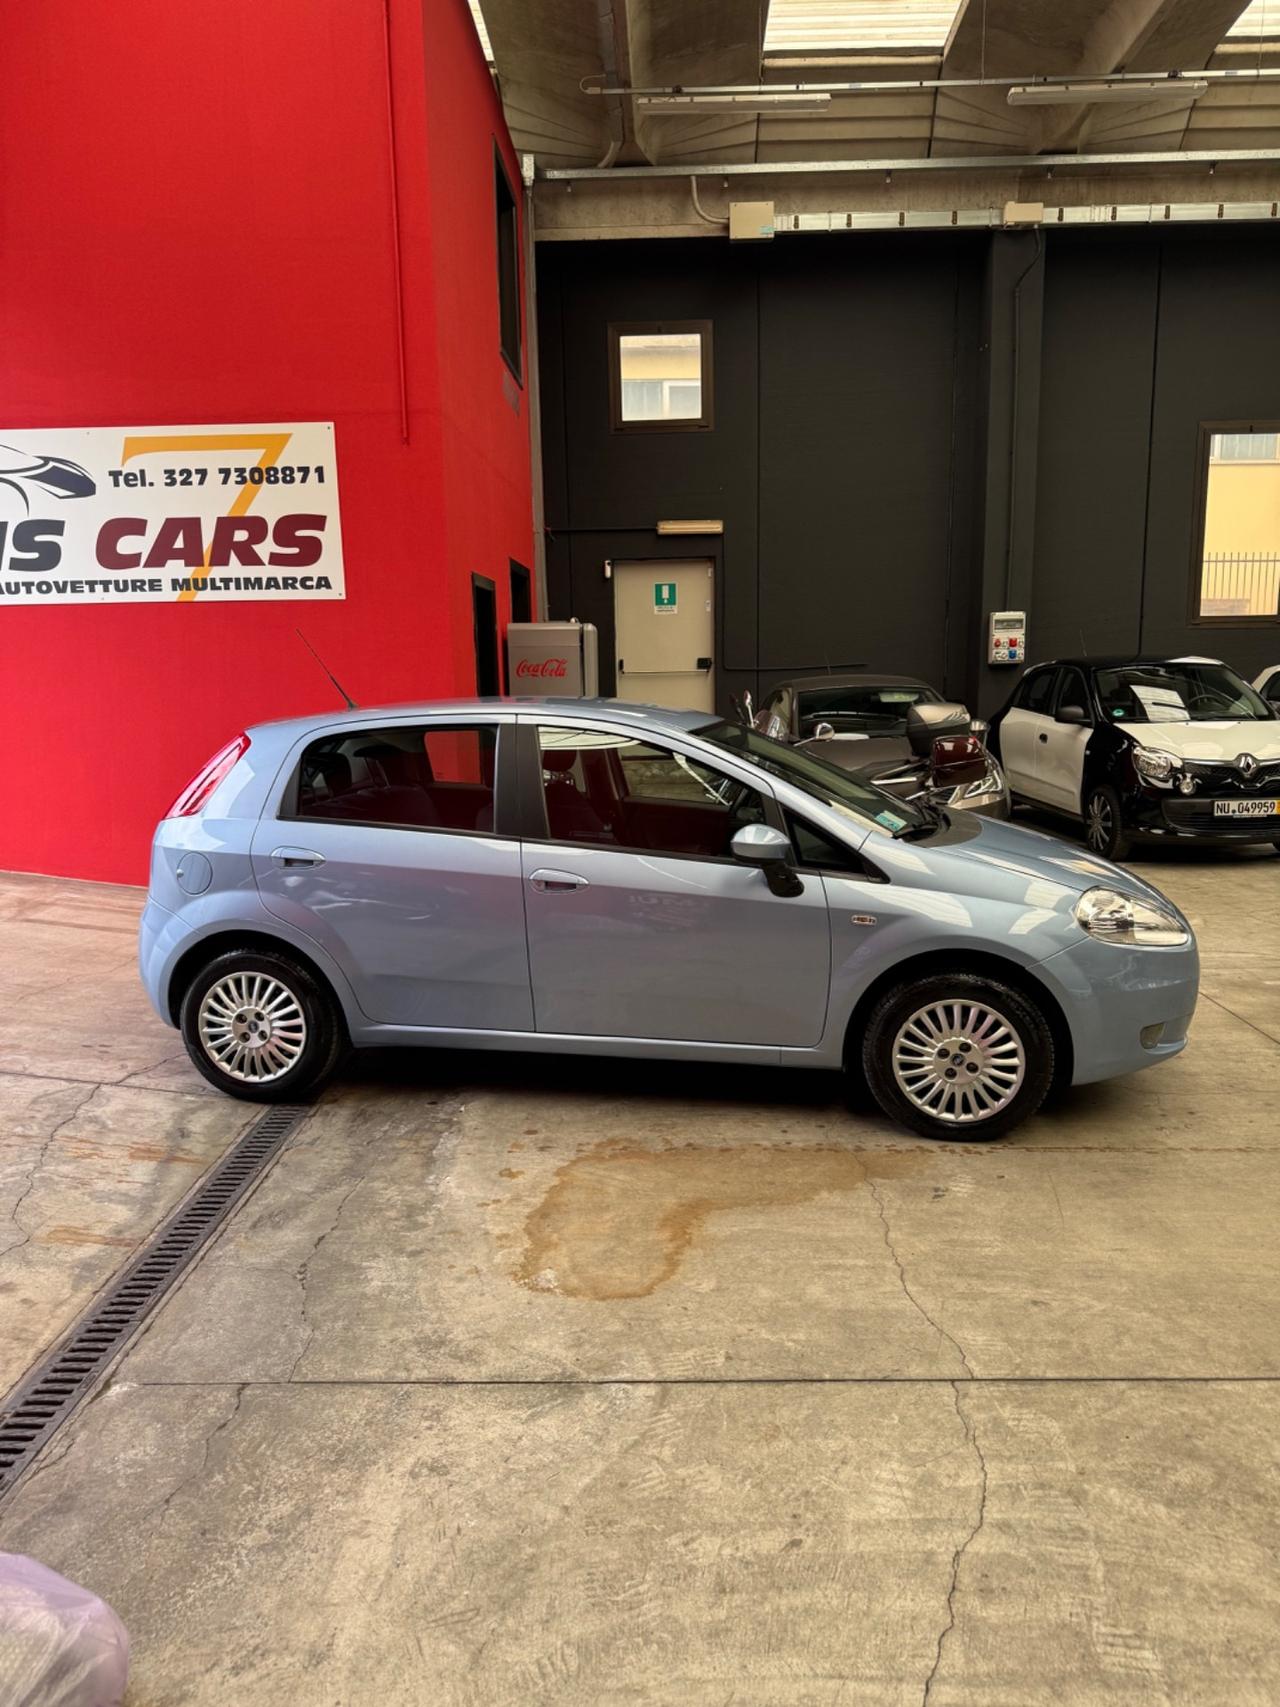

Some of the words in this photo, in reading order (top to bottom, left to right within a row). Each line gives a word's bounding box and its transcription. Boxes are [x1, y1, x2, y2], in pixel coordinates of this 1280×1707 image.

[108, 469, 155, 488] Tel.
[164, 468, 208, 487] 327
[218, 465, 325, 485] 7308871
[95, 513, 327, 570] CARS
[171, 576, 332, 591] MULTIMARCA
